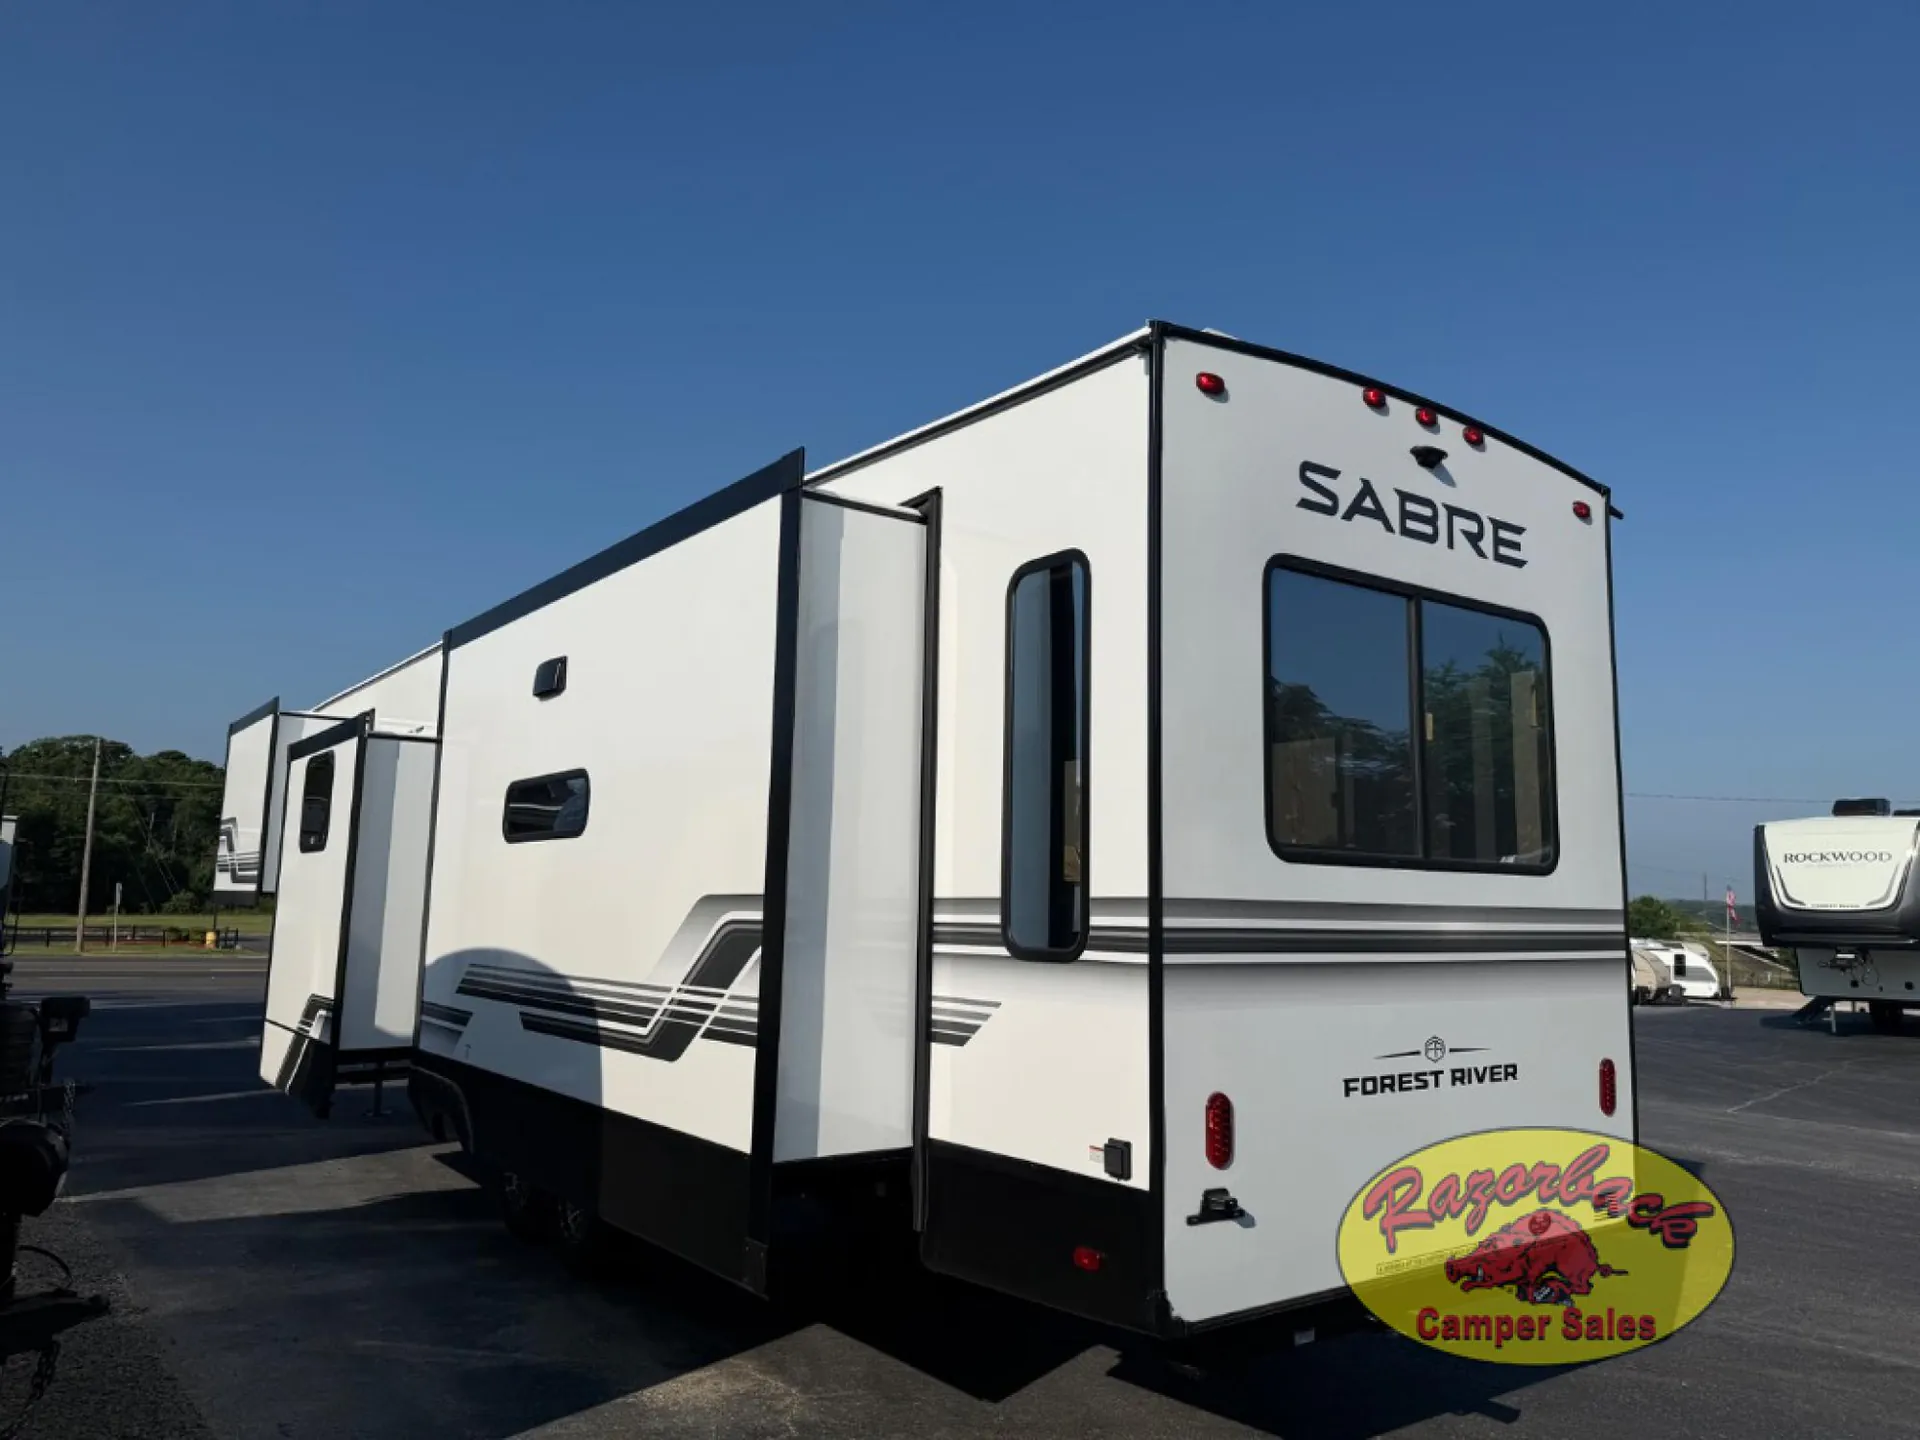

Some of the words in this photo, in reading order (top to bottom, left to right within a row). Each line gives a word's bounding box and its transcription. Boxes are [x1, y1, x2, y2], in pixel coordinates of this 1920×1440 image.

[1296, 460, 1528, 568] SABRE
[1784, 851, 1892, 863] ROCKWOOD
[1342, 1070, 1444, 1097] FOREST
[1450, 1063, 1518, 1087] RIVER
